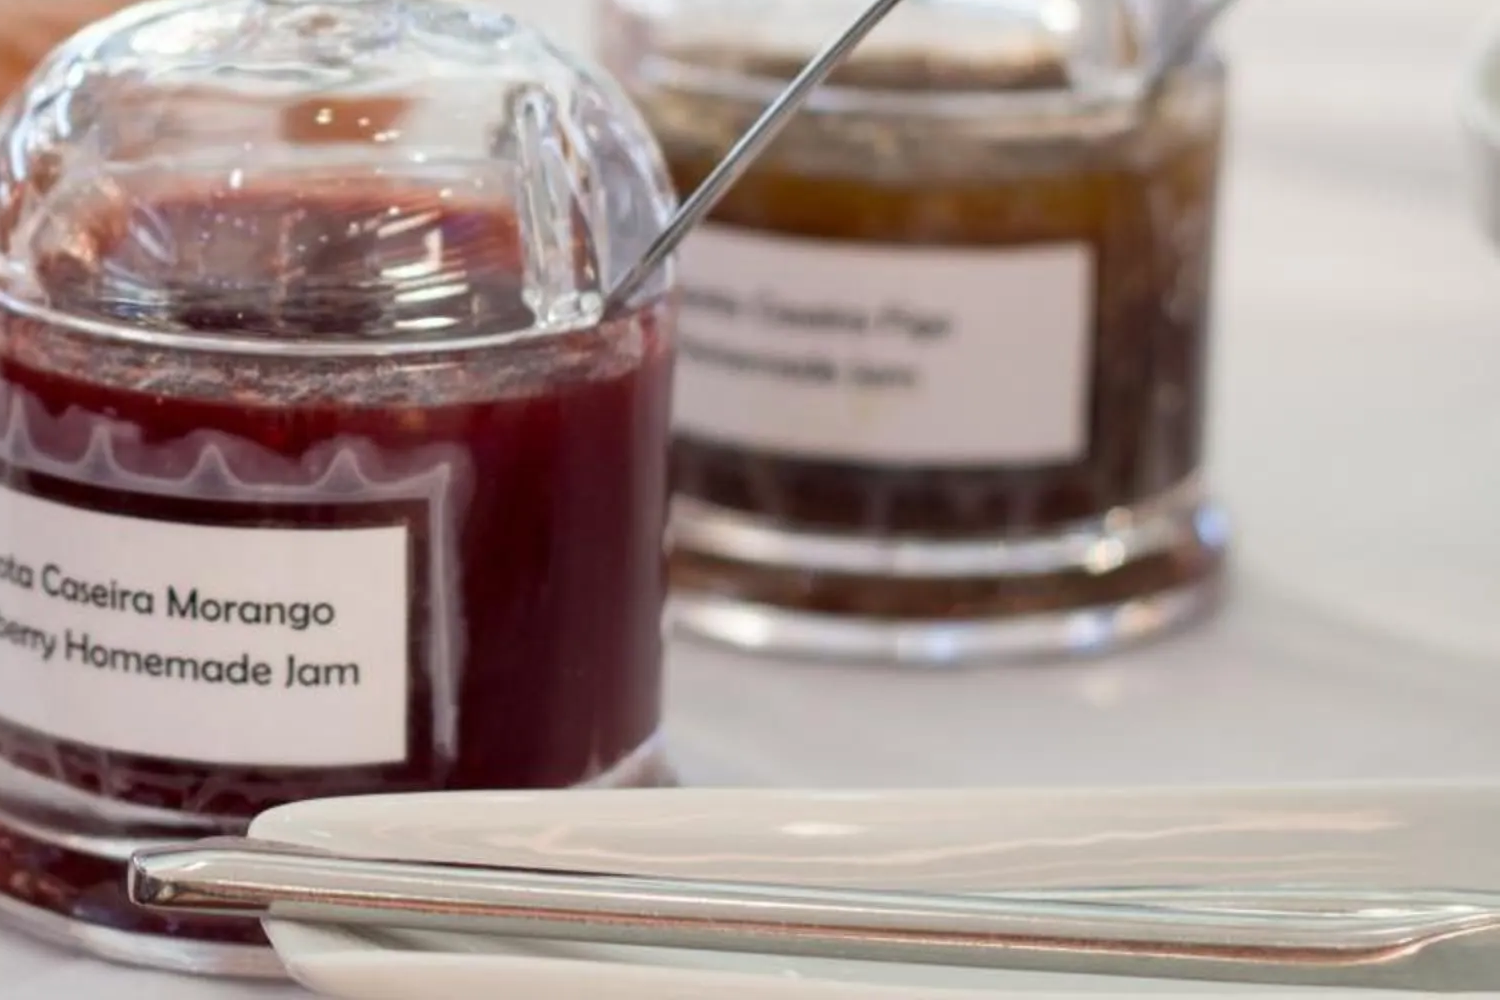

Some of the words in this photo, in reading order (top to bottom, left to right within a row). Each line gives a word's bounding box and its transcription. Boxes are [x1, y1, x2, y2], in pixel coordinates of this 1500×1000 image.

[41, 563, 154, 615] Caseira
[167, 586, 336, 631] Morango
[65, 629, 272, 687] Homemade
[284, 655, 361, 689] Jam
